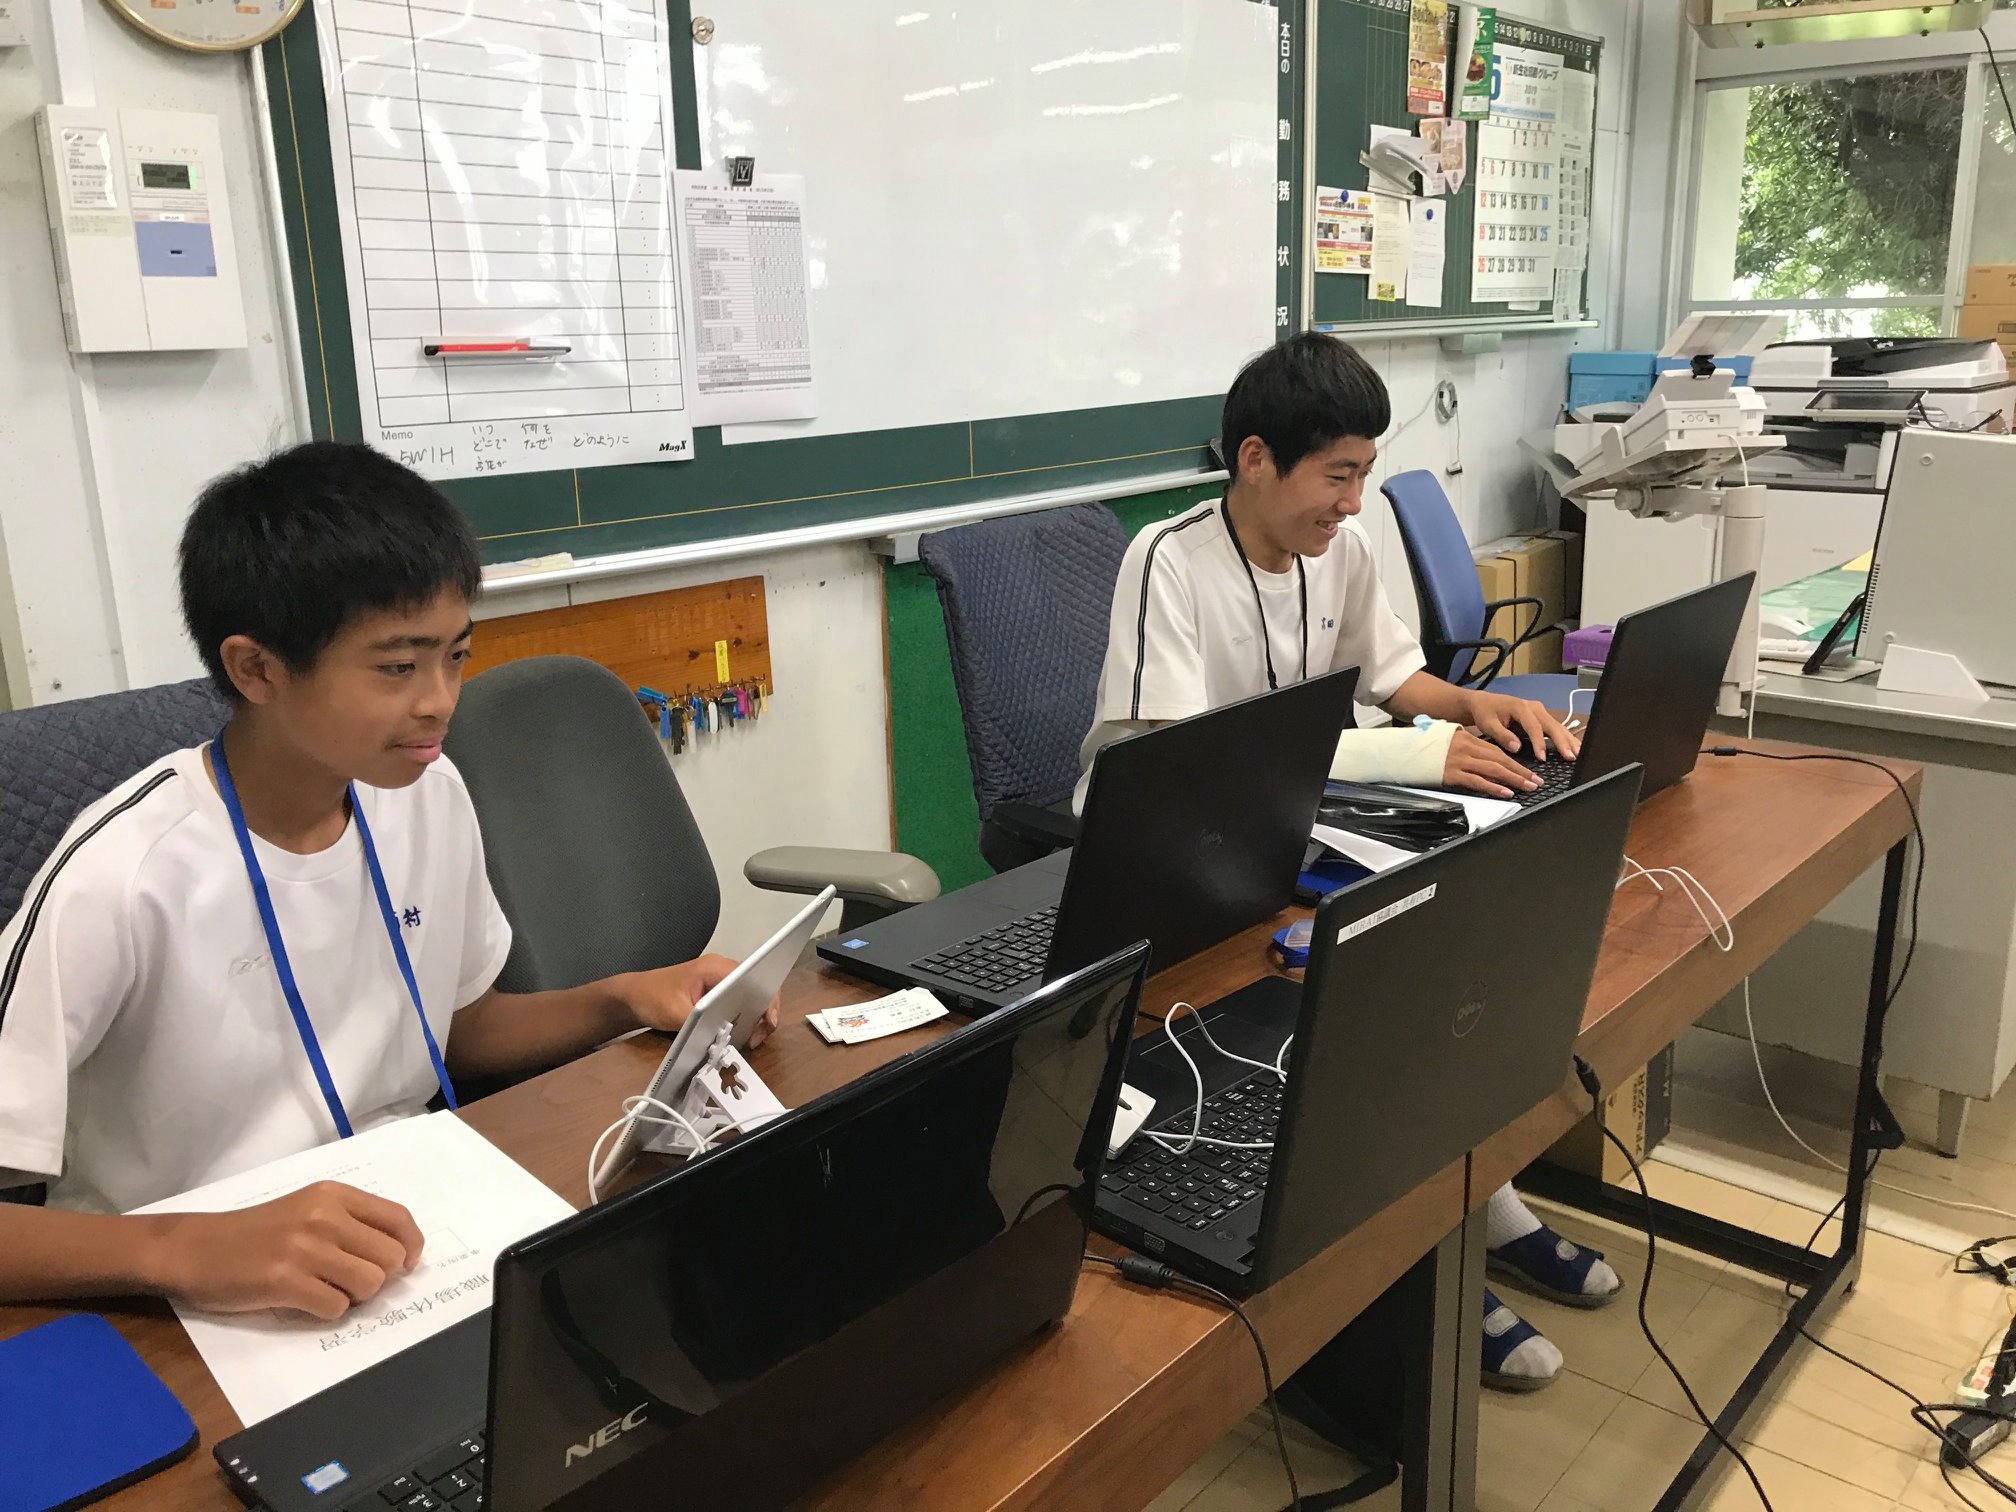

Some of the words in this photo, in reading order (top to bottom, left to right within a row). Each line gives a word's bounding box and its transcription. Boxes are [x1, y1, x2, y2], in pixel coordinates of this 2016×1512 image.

[1523, 130, 1527, 146] 2
[1533, 132, 1537, 147] 3
[1544, 132, 1548, 148] 4
[1482, 158, 1485, 174] 5
[1491, 160, 1495, 175] 6
[1501, 161, 1505, 176] 7
[1511, 162, 1516, 177] 8
[1522, 162, 1526, 178] 9
[1533, 164, 1538, 179] 10
[1543, 165, 1549, 180] 11
[1481, 192, 1486, 207] 12
[1490, 193, 1496, 208] 13
[1500, 194, 1506, 208] 14
[1510, 194, 1517, 209] 15
[1521, 195, 1527, 210] 16
[1531, 195, 1537, 210] 17
[1542, 196, 1548, 211] 18
[1480, 225, 1485, 240] 19
[1489, 226, 1495, 240] 20
[1499, 226, 1505, 240] 21
[1509, 226, 1516, 241] 22
[1519, 226, 1526, 241] 23
[1530, 227, 1537, 241] 24
[1540, 227, 1548, 242] 25
[1478, 258, 1485, 272] 26
[1488, 258, 1495, 272] 27
[1498, 258, 1504, 272] 28
[1508, 258, 1514, 272] 29
[1518, 258, 1525, 272] 30
[1528, 258, 1535, 272] 31
[381, 431, 413, 441] Memo
[472, 424, 494, 435] いつ
[521, 423, 551, 435] 何を
[473, 436, 507, 451] どこで
[523, 436, 553, 450] なぜ
[573, 432, 630, 448] どのように
[658, 440, 687, 452] MagX
[319, 1273, 490, 1351] 職場体験学習
[565, 1402, 649, 1468] NEC
